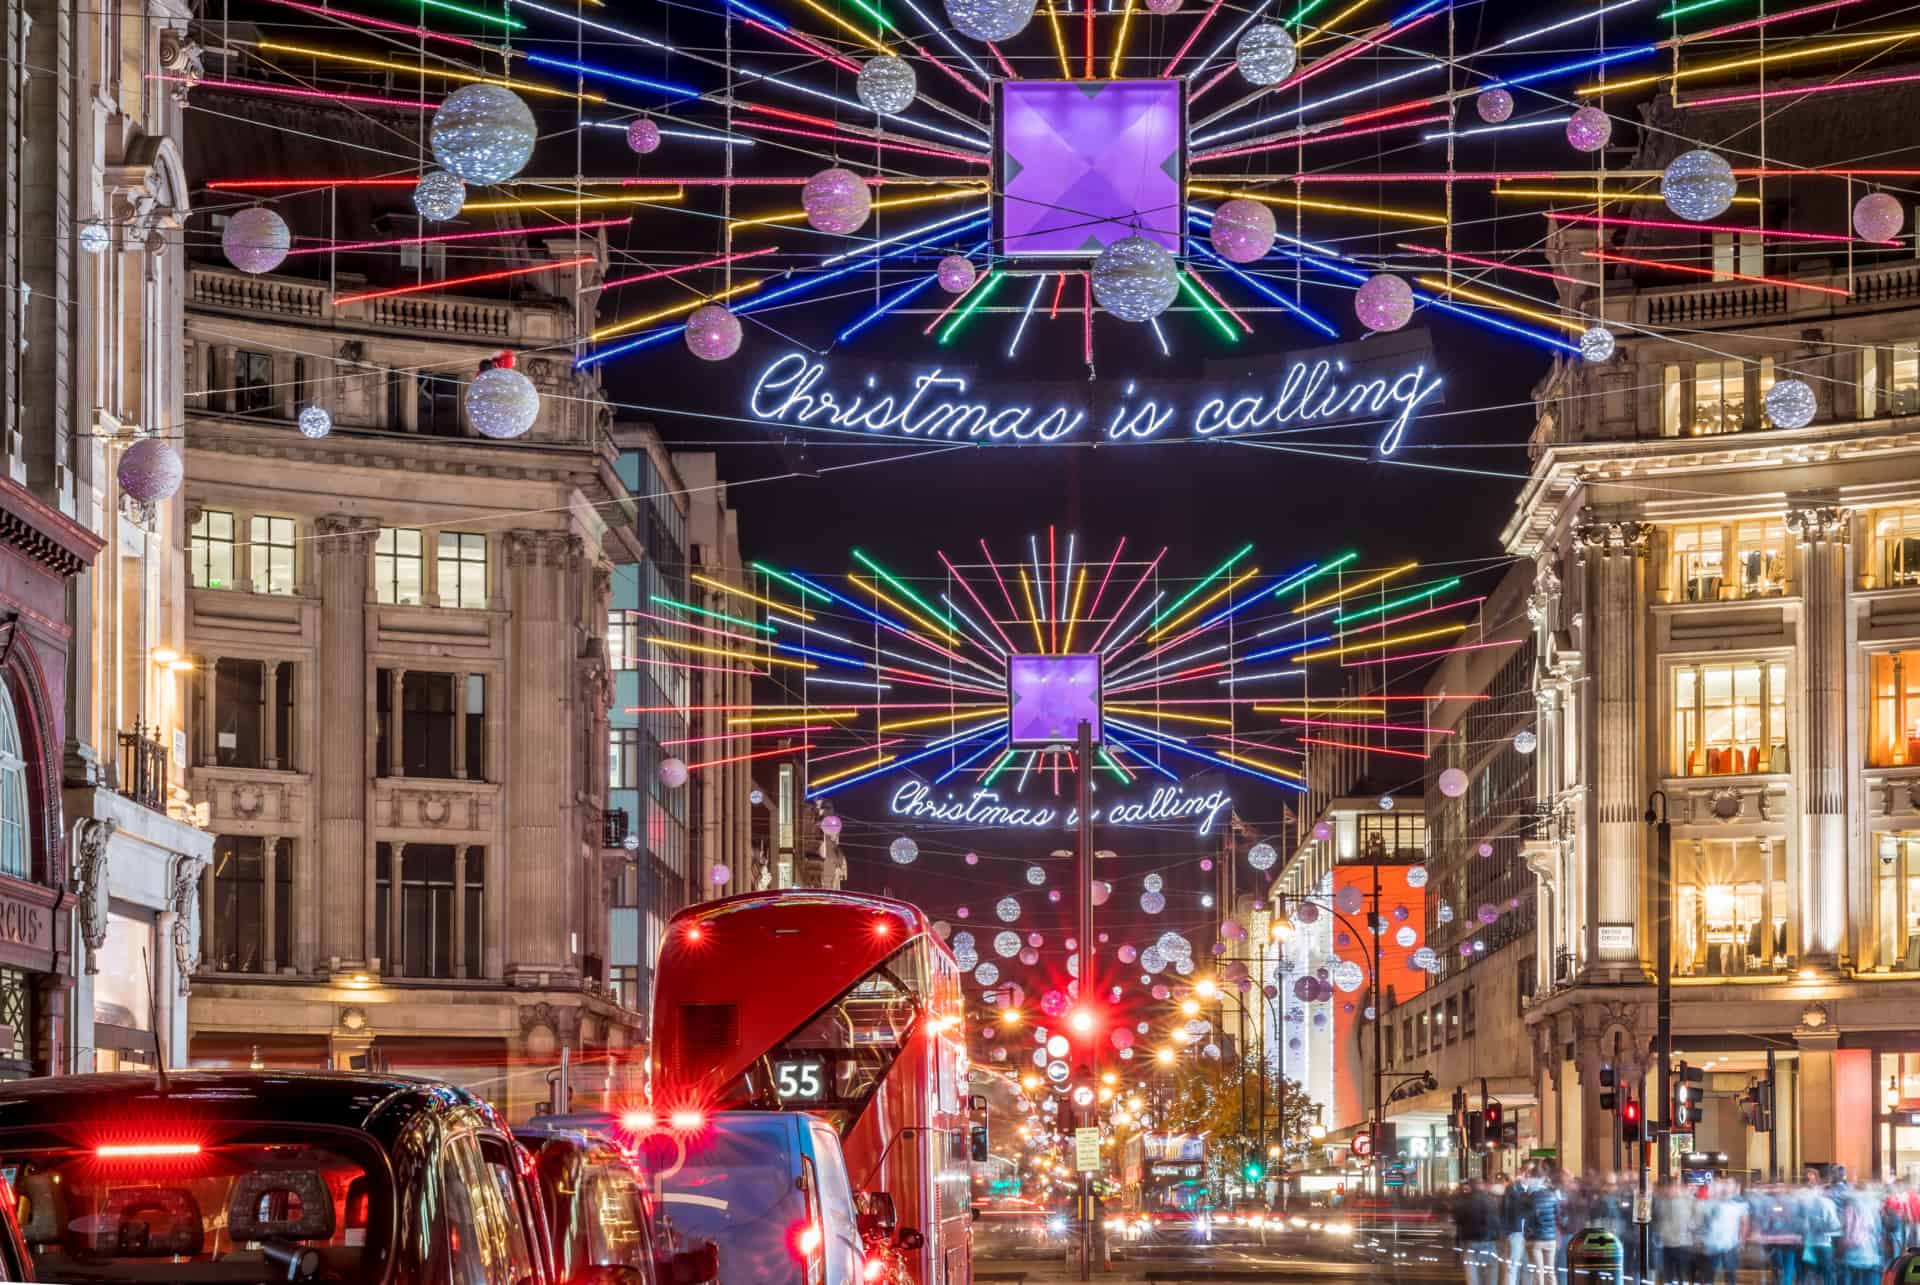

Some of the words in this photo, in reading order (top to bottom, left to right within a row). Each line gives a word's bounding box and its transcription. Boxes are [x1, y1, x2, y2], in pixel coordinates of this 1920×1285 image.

[751, 352, 1084, 440] Christmas
[1109, 383, 1174, 438] is
[1195, 359, 1443, 454] calling
[891, 779, 1056, 825] Christmas
[1108, 786, 1232, 835] calling
[778, 1064, 820, 1097] 55
